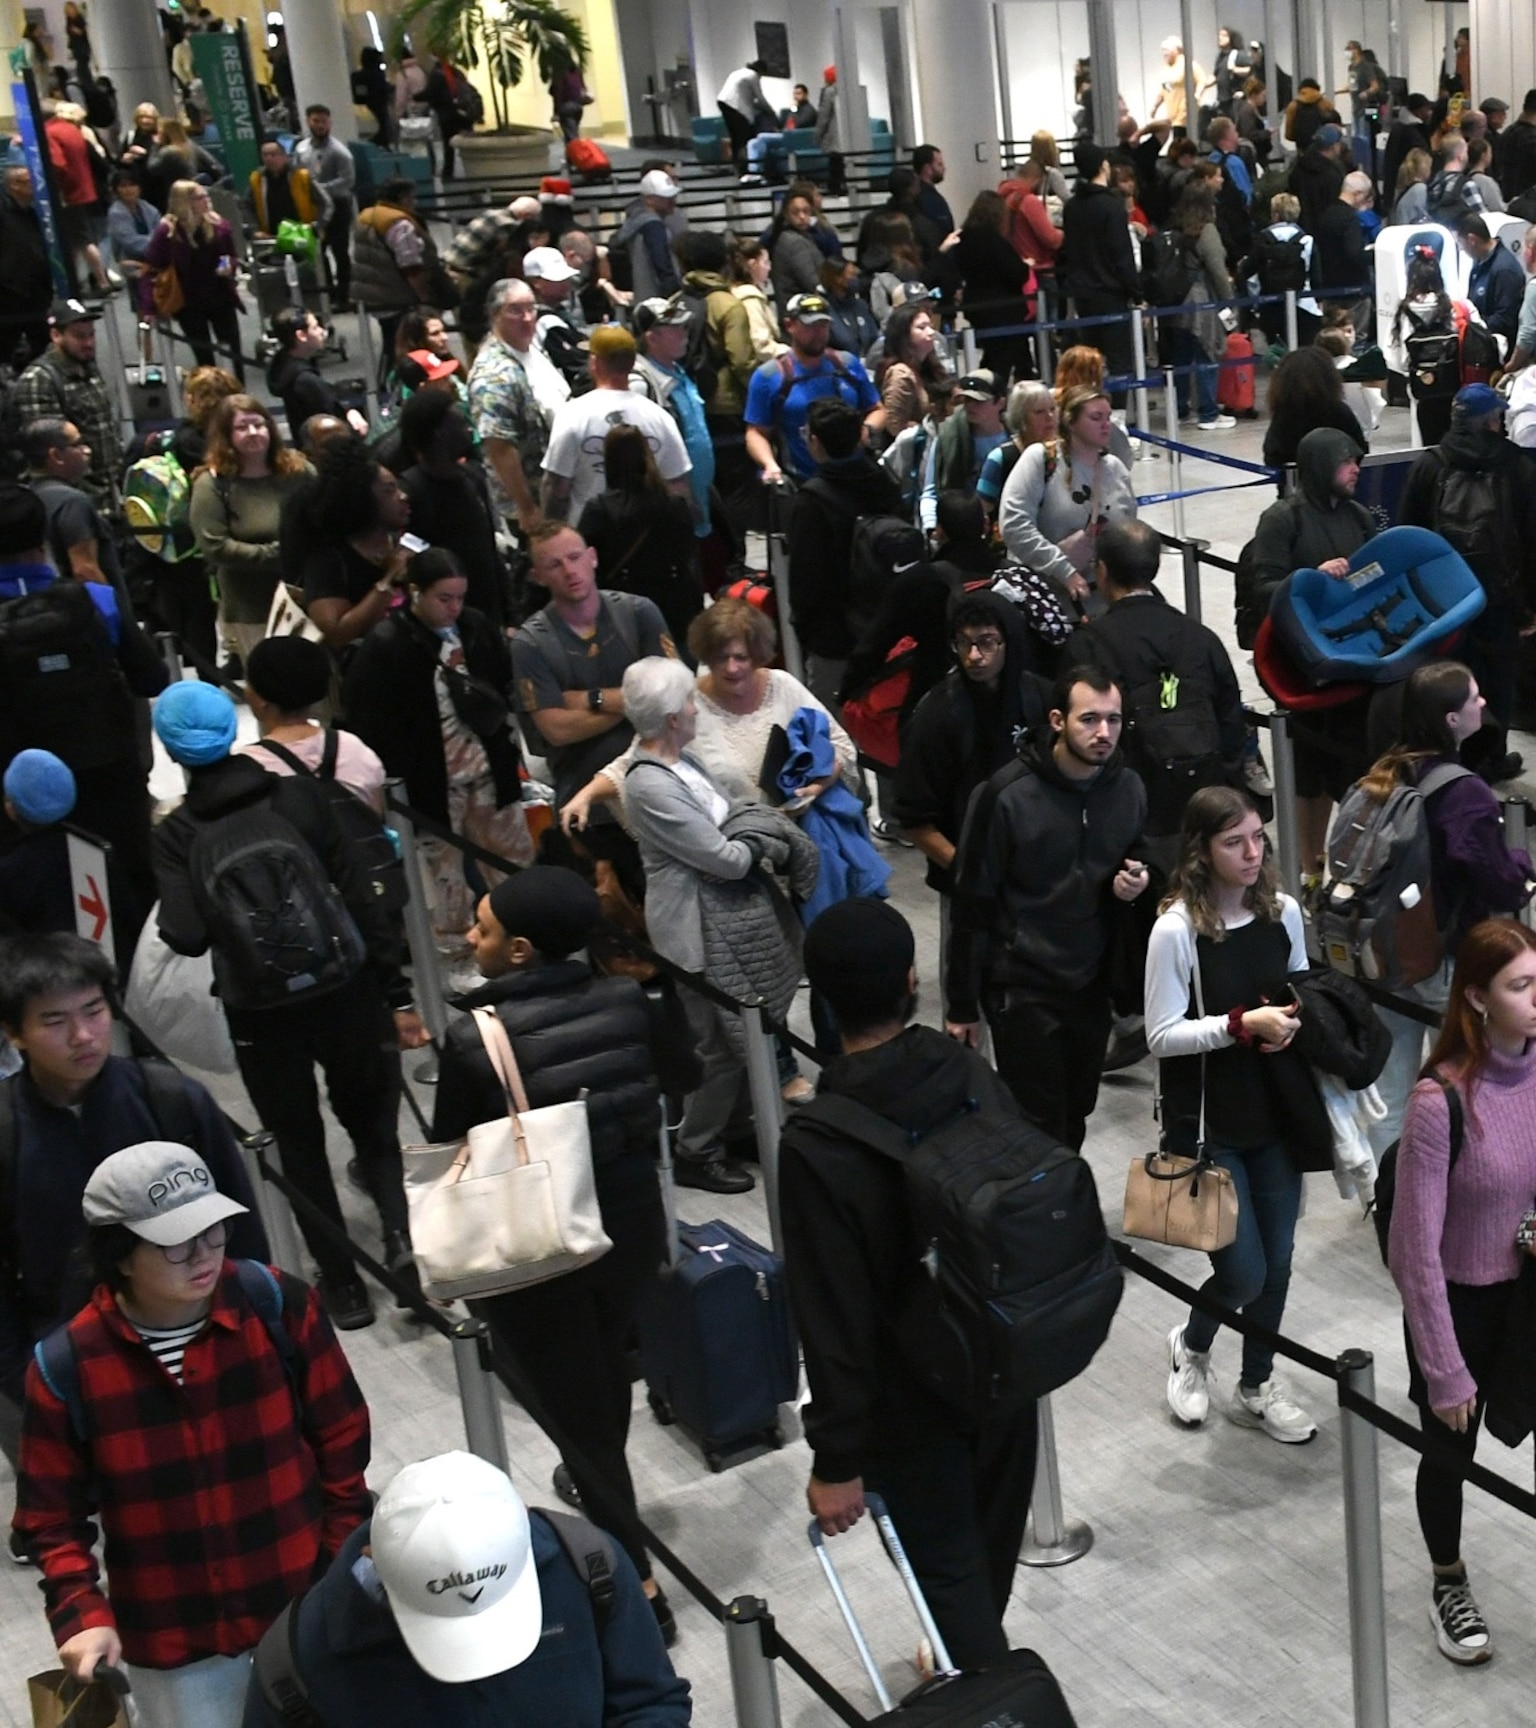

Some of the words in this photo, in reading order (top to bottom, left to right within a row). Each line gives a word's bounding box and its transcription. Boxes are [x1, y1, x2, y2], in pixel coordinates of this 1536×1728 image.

[221, 45, 256, 140] RESERVE
[148, 1167, 209, 1207] ping
[425, 1562, 508, 1595] Callaway
